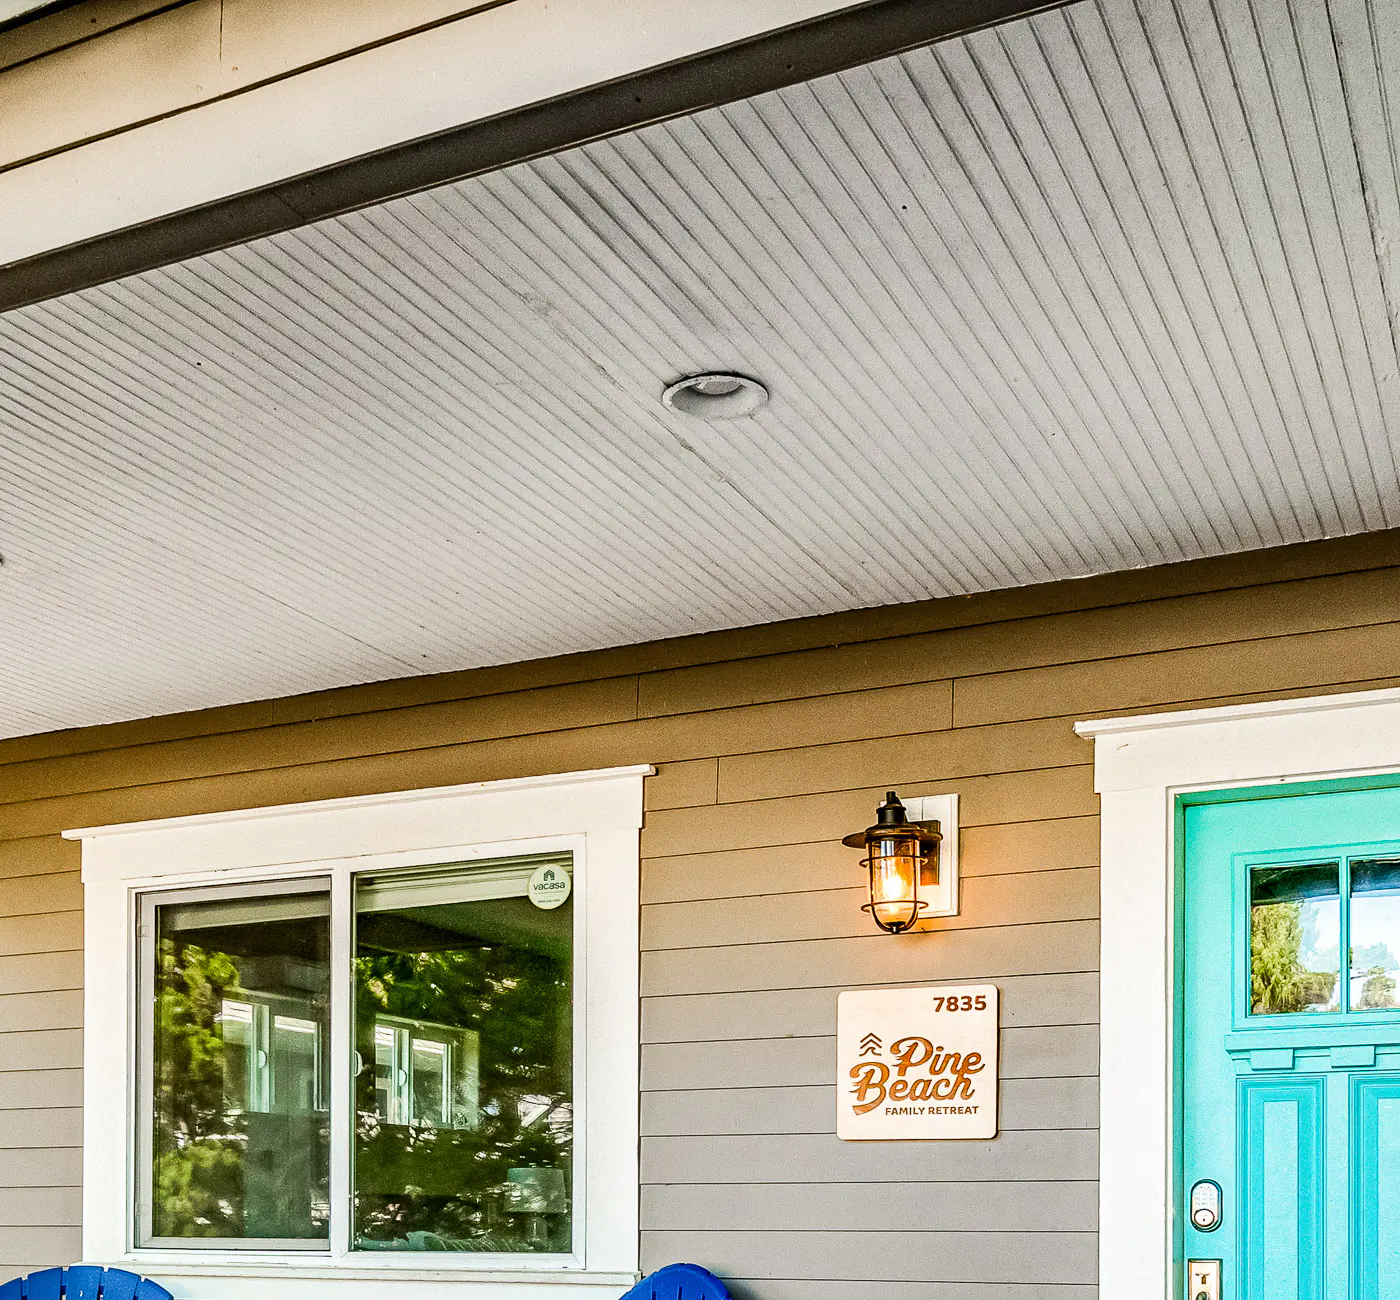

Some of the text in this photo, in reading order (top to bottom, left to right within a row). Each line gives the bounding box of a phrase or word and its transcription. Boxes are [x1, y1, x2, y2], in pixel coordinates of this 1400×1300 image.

[533, 881, 566, 890] vacasa
[933, 995, 987, 1012] 7835
[890, 1036, 985, 1076] Pine
[848, 1061, 975, 1116] Beach
[885, 1105, 979, 1116] FAMILY RETREAT
